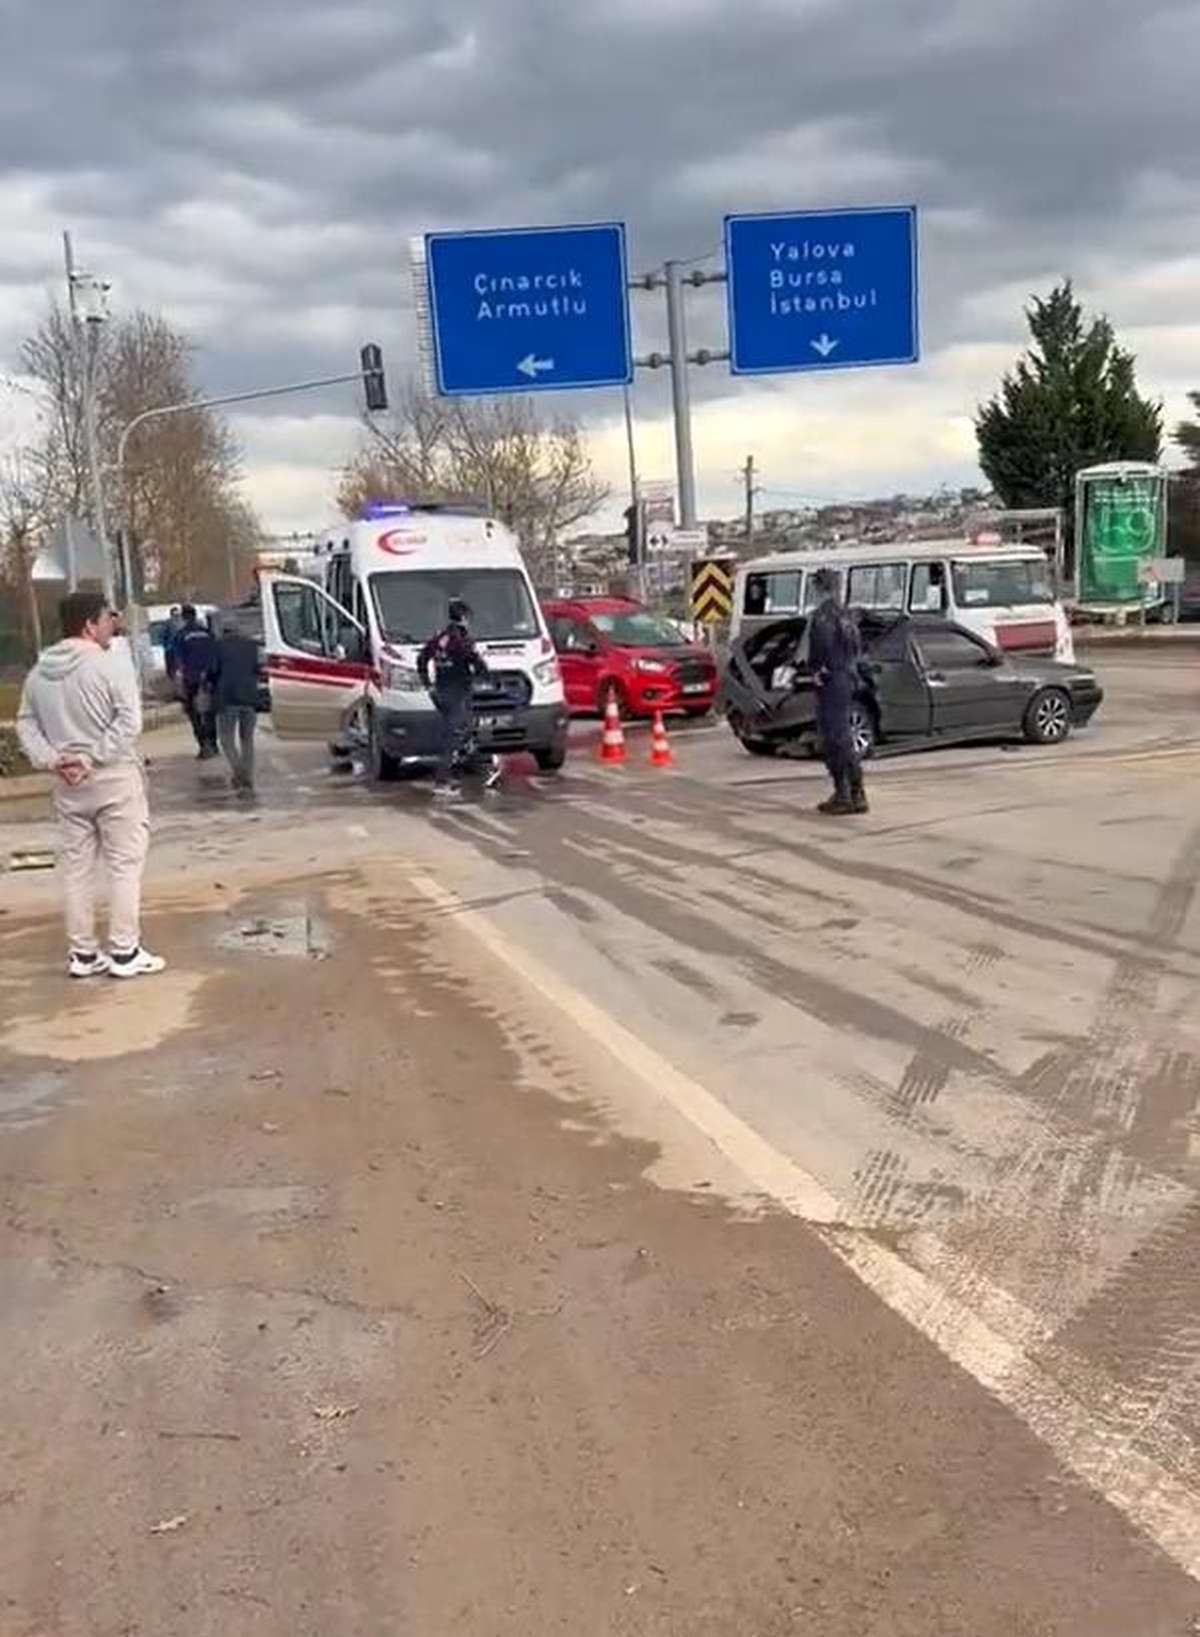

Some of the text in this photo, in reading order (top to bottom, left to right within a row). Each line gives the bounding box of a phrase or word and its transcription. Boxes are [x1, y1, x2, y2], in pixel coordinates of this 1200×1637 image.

[770, 242, 855, 260] Yalova
[474, 271, 583, 295] Çınarcık
[770, 269, 842, 288] Bursa
[476, 299, 588, 321] Armutlu
[770, 290, 878, 314] İstanbul
